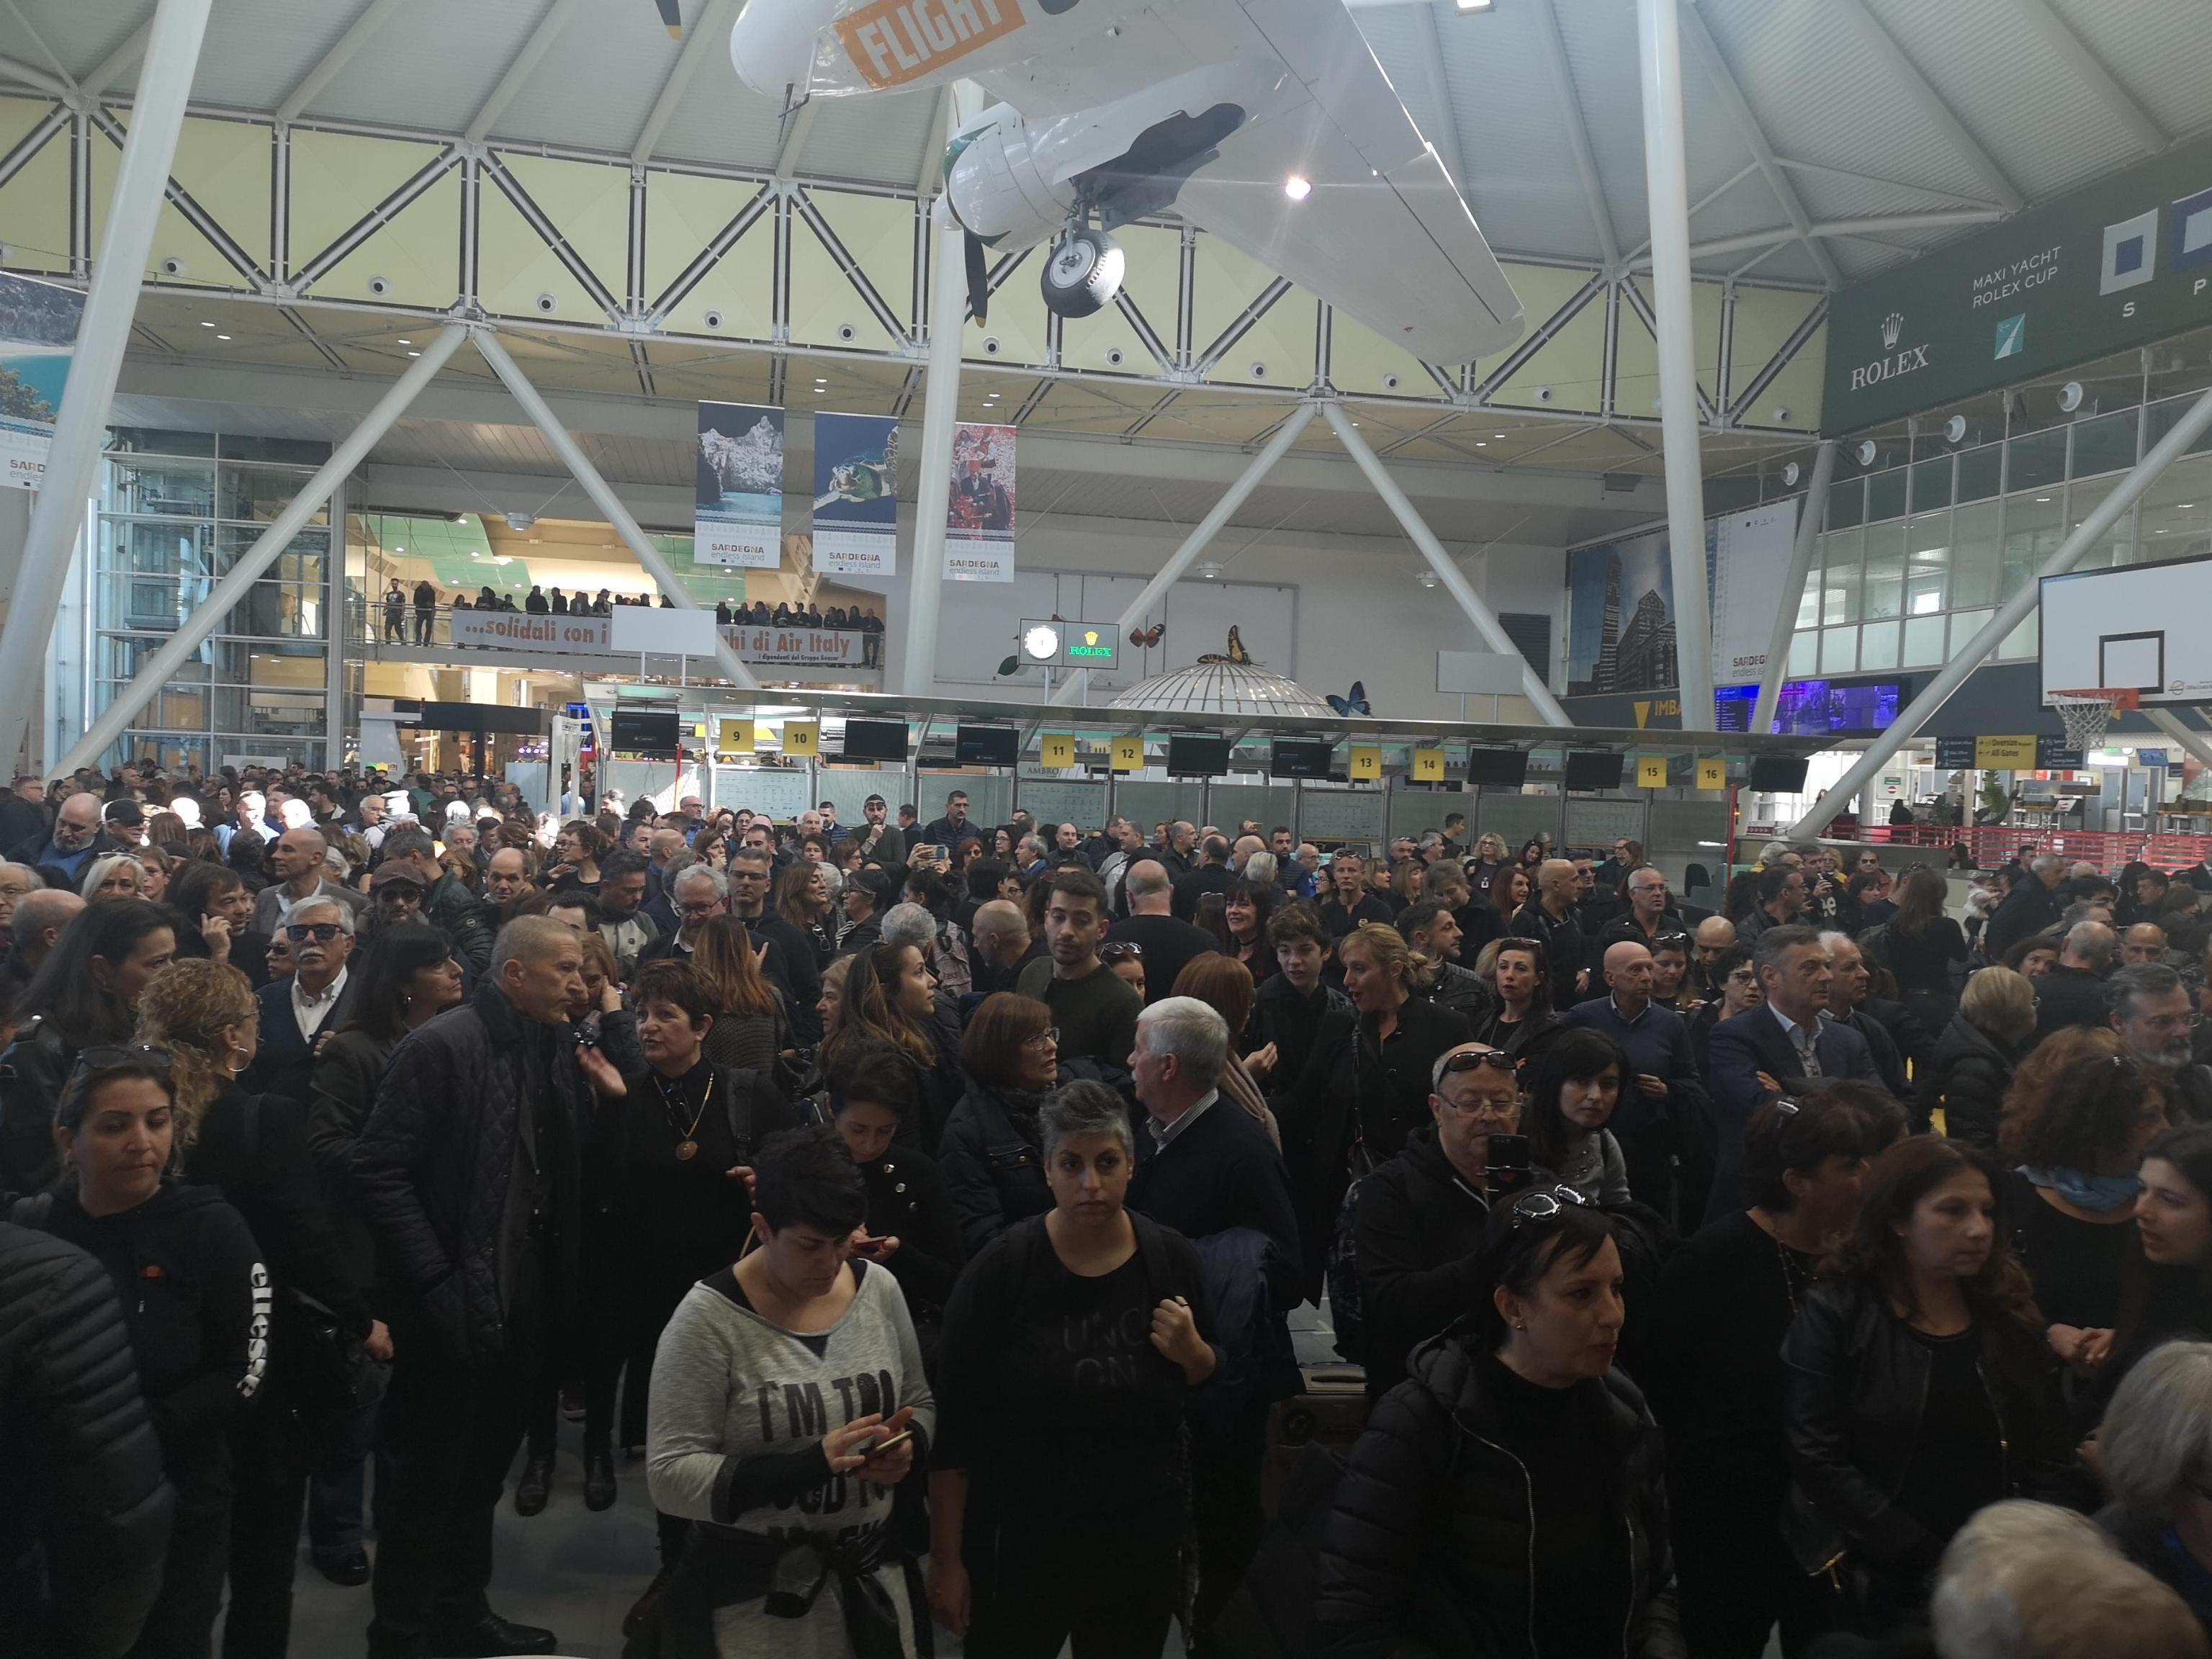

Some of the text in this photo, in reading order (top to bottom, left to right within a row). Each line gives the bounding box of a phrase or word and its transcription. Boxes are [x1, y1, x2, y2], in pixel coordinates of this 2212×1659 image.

[1973, 246, 2062, 291] MAXI YACHT
[1973, 266, 2059, 308] ROLEX CUP
[2193, 278, 2207, 295] P
[2123, 302, 2135, 317] S
[1850, 344, 1929, 391] ROLEX
[711, 543, 764, 554] SARDEGNA
[829, 552, 881, 562] SARDEGNA
[949, 559, 999, 568] SARDEGNA
[564, 626, 594, 643] con
[601, 624, 607, 644] i
[753, 630, 770, 652] di
[776, 632, 803, 652] Air
[809, 631, 850, 658] Italy
[1069, 646, 1112, 657] ROLEX
[1732, 655, 1768, 667] SARDEG
[733, 732, 740, 741] 9
[793, 733, 806, 743] 10
[1053, 746, 1064, 755] 11
[1122, 749, 1134, 758] 12
[1360, 757, 1372, 768] 13
[1424, 760, 1435, 770] 14
[1647, 767, 1658, 777] 15
[1706, 769, 1717, 779] 16
[236, 1262, 273, 1398] ellesse
[757, 1380, 827, 1442] I'M
